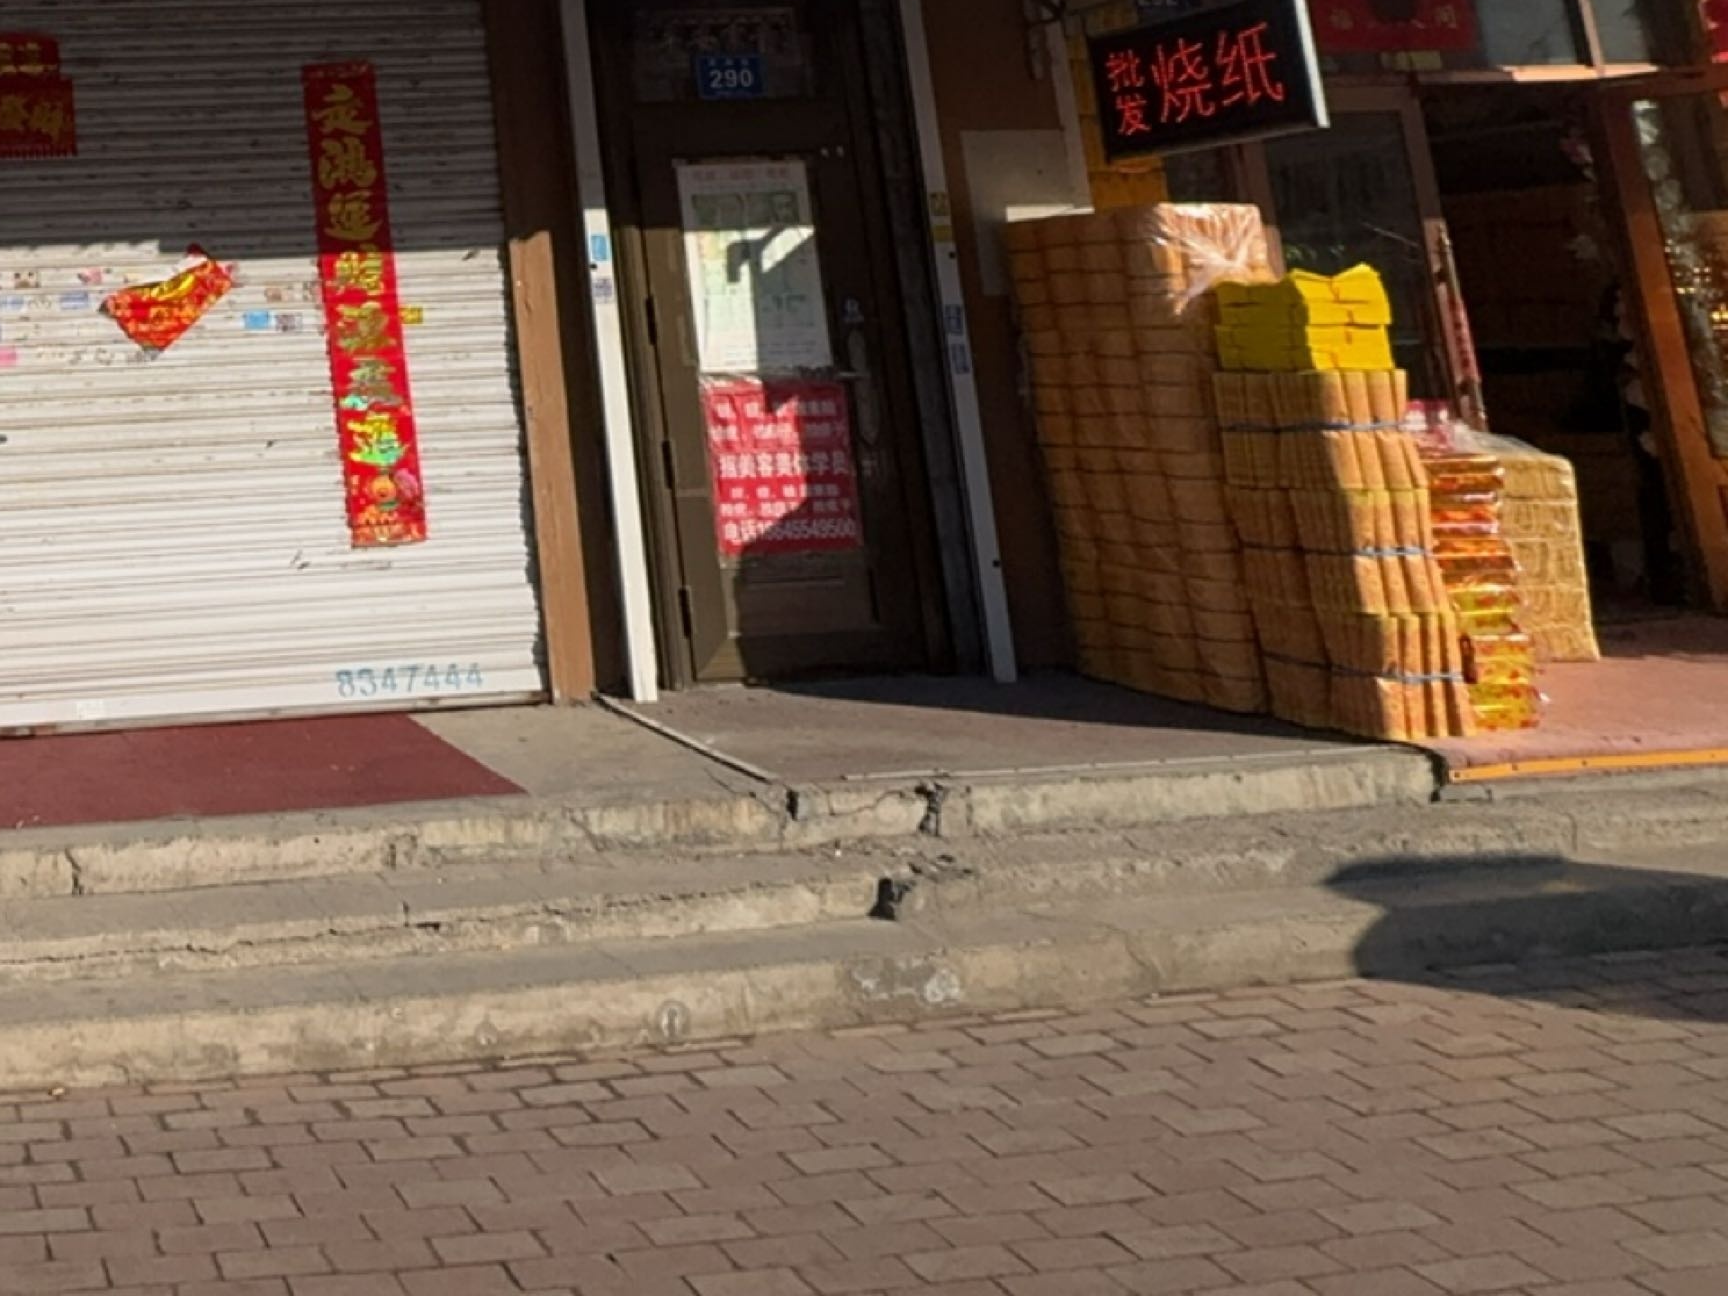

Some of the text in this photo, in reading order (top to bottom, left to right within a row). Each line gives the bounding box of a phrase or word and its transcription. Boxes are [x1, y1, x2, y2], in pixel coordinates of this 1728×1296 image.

[708, 67, 755, 90] 290
[1152, 22, 1284, 124] 烧纸
[335, 661, 484, 698] 8347444
